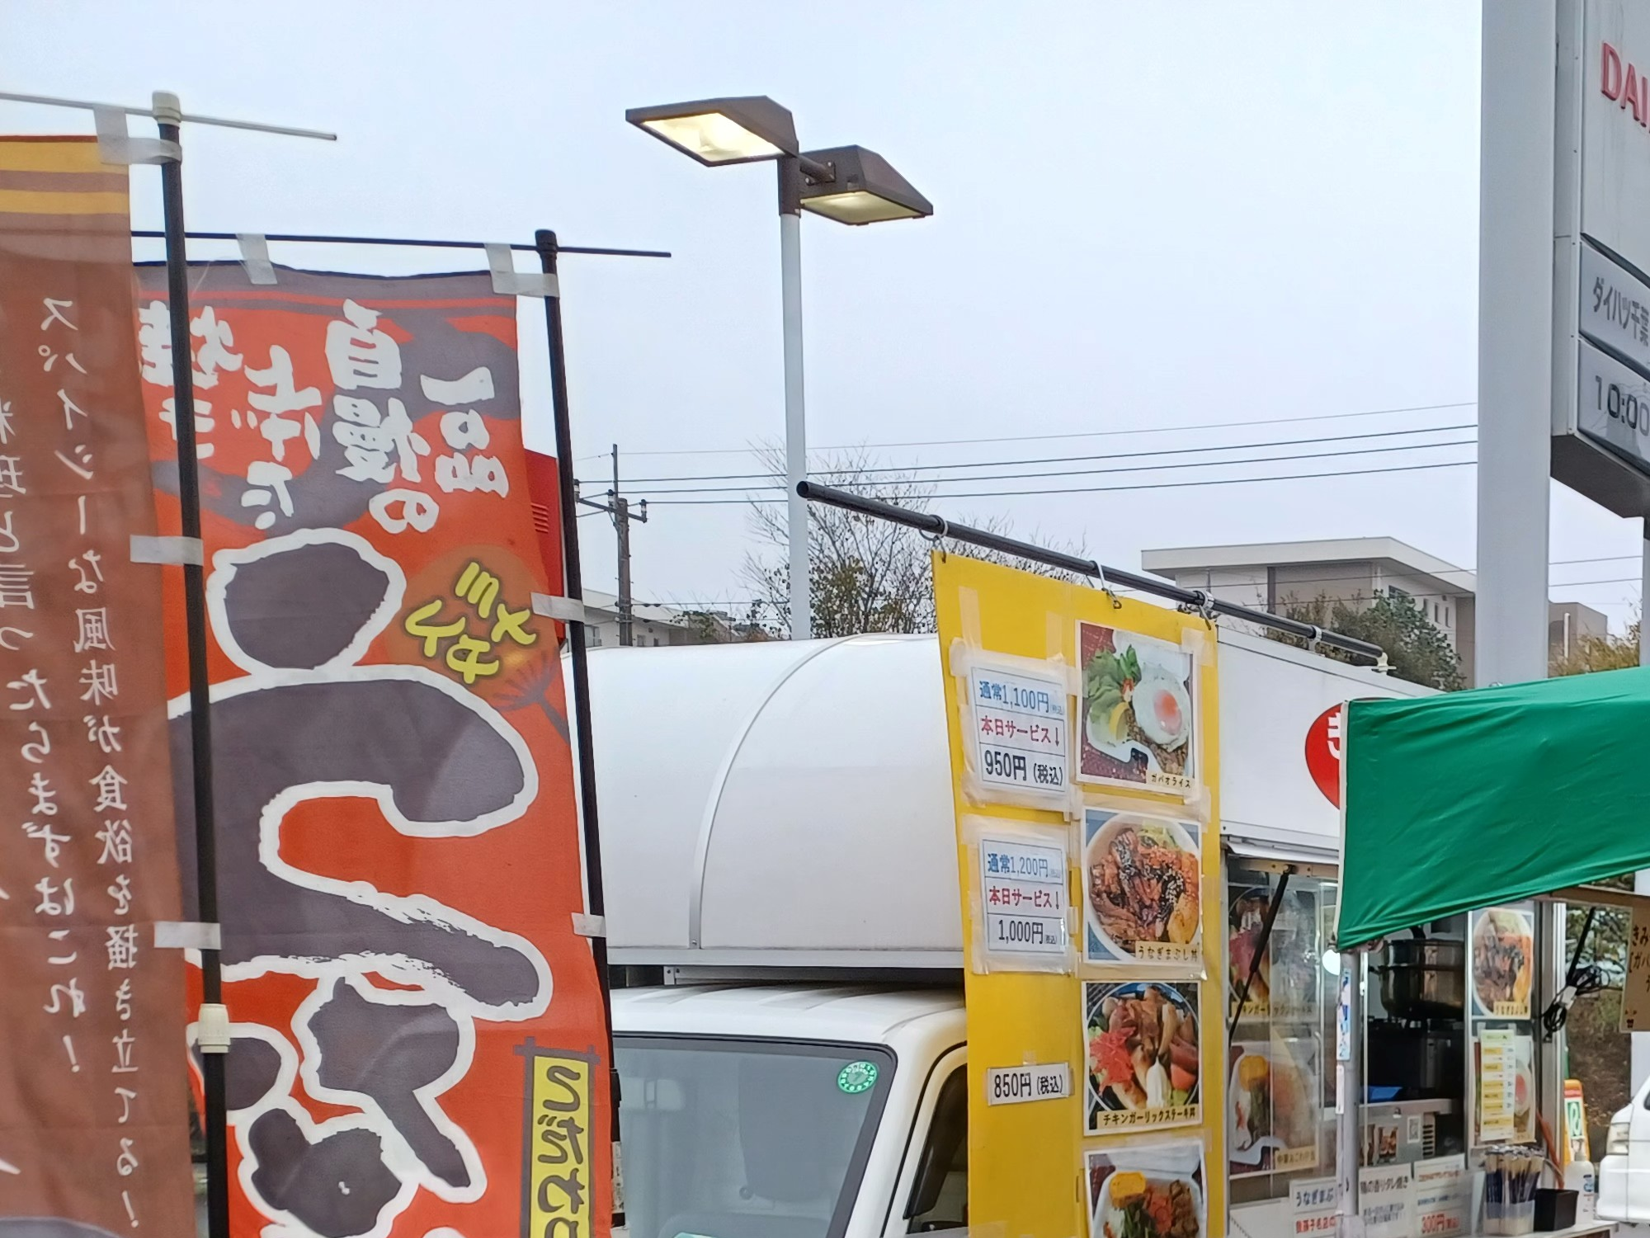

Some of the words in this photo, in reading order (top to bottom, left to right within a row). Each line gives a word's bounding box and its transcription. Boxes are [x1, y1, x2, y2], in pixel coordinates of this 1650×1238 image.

[981, 715, 1052, 744] 本日サービス
[984, 750, 1027, 781] 950円
[1033, 763, 1064, 786] (税込)
[989, 885, 1053, 908] 本日サービス
[994, 1071, 1032, 1098] 850円
[1037, 1074, 1063, 1096] (税込)
